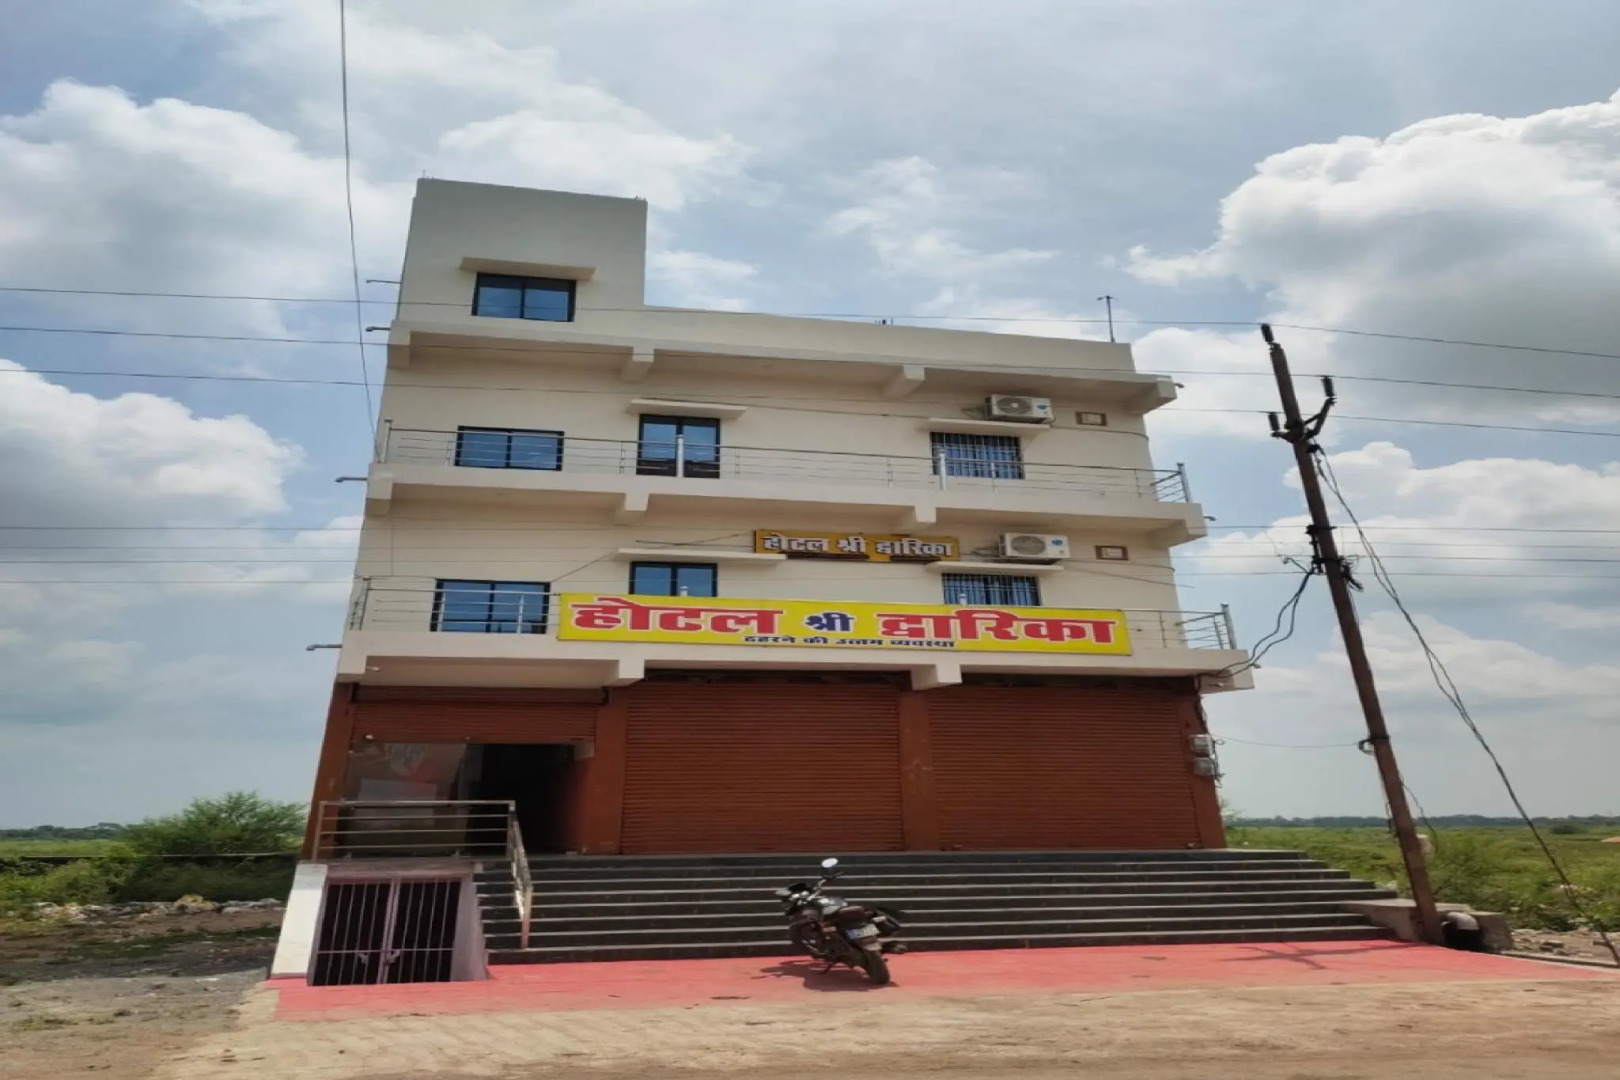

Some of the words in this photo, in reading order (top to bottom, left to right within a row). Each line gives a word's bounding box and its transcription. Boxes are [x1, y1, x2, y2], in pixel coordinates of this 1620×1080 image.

[762, 532, 829, 551] होटल
[837, 536, 867, 553] श्री
[570, 596, 783, 634] होटल
[805, 612, 854, 632] श्री
[877, 609, 1117, 643] द्वारिका
[804, 636, 829, 645] की
